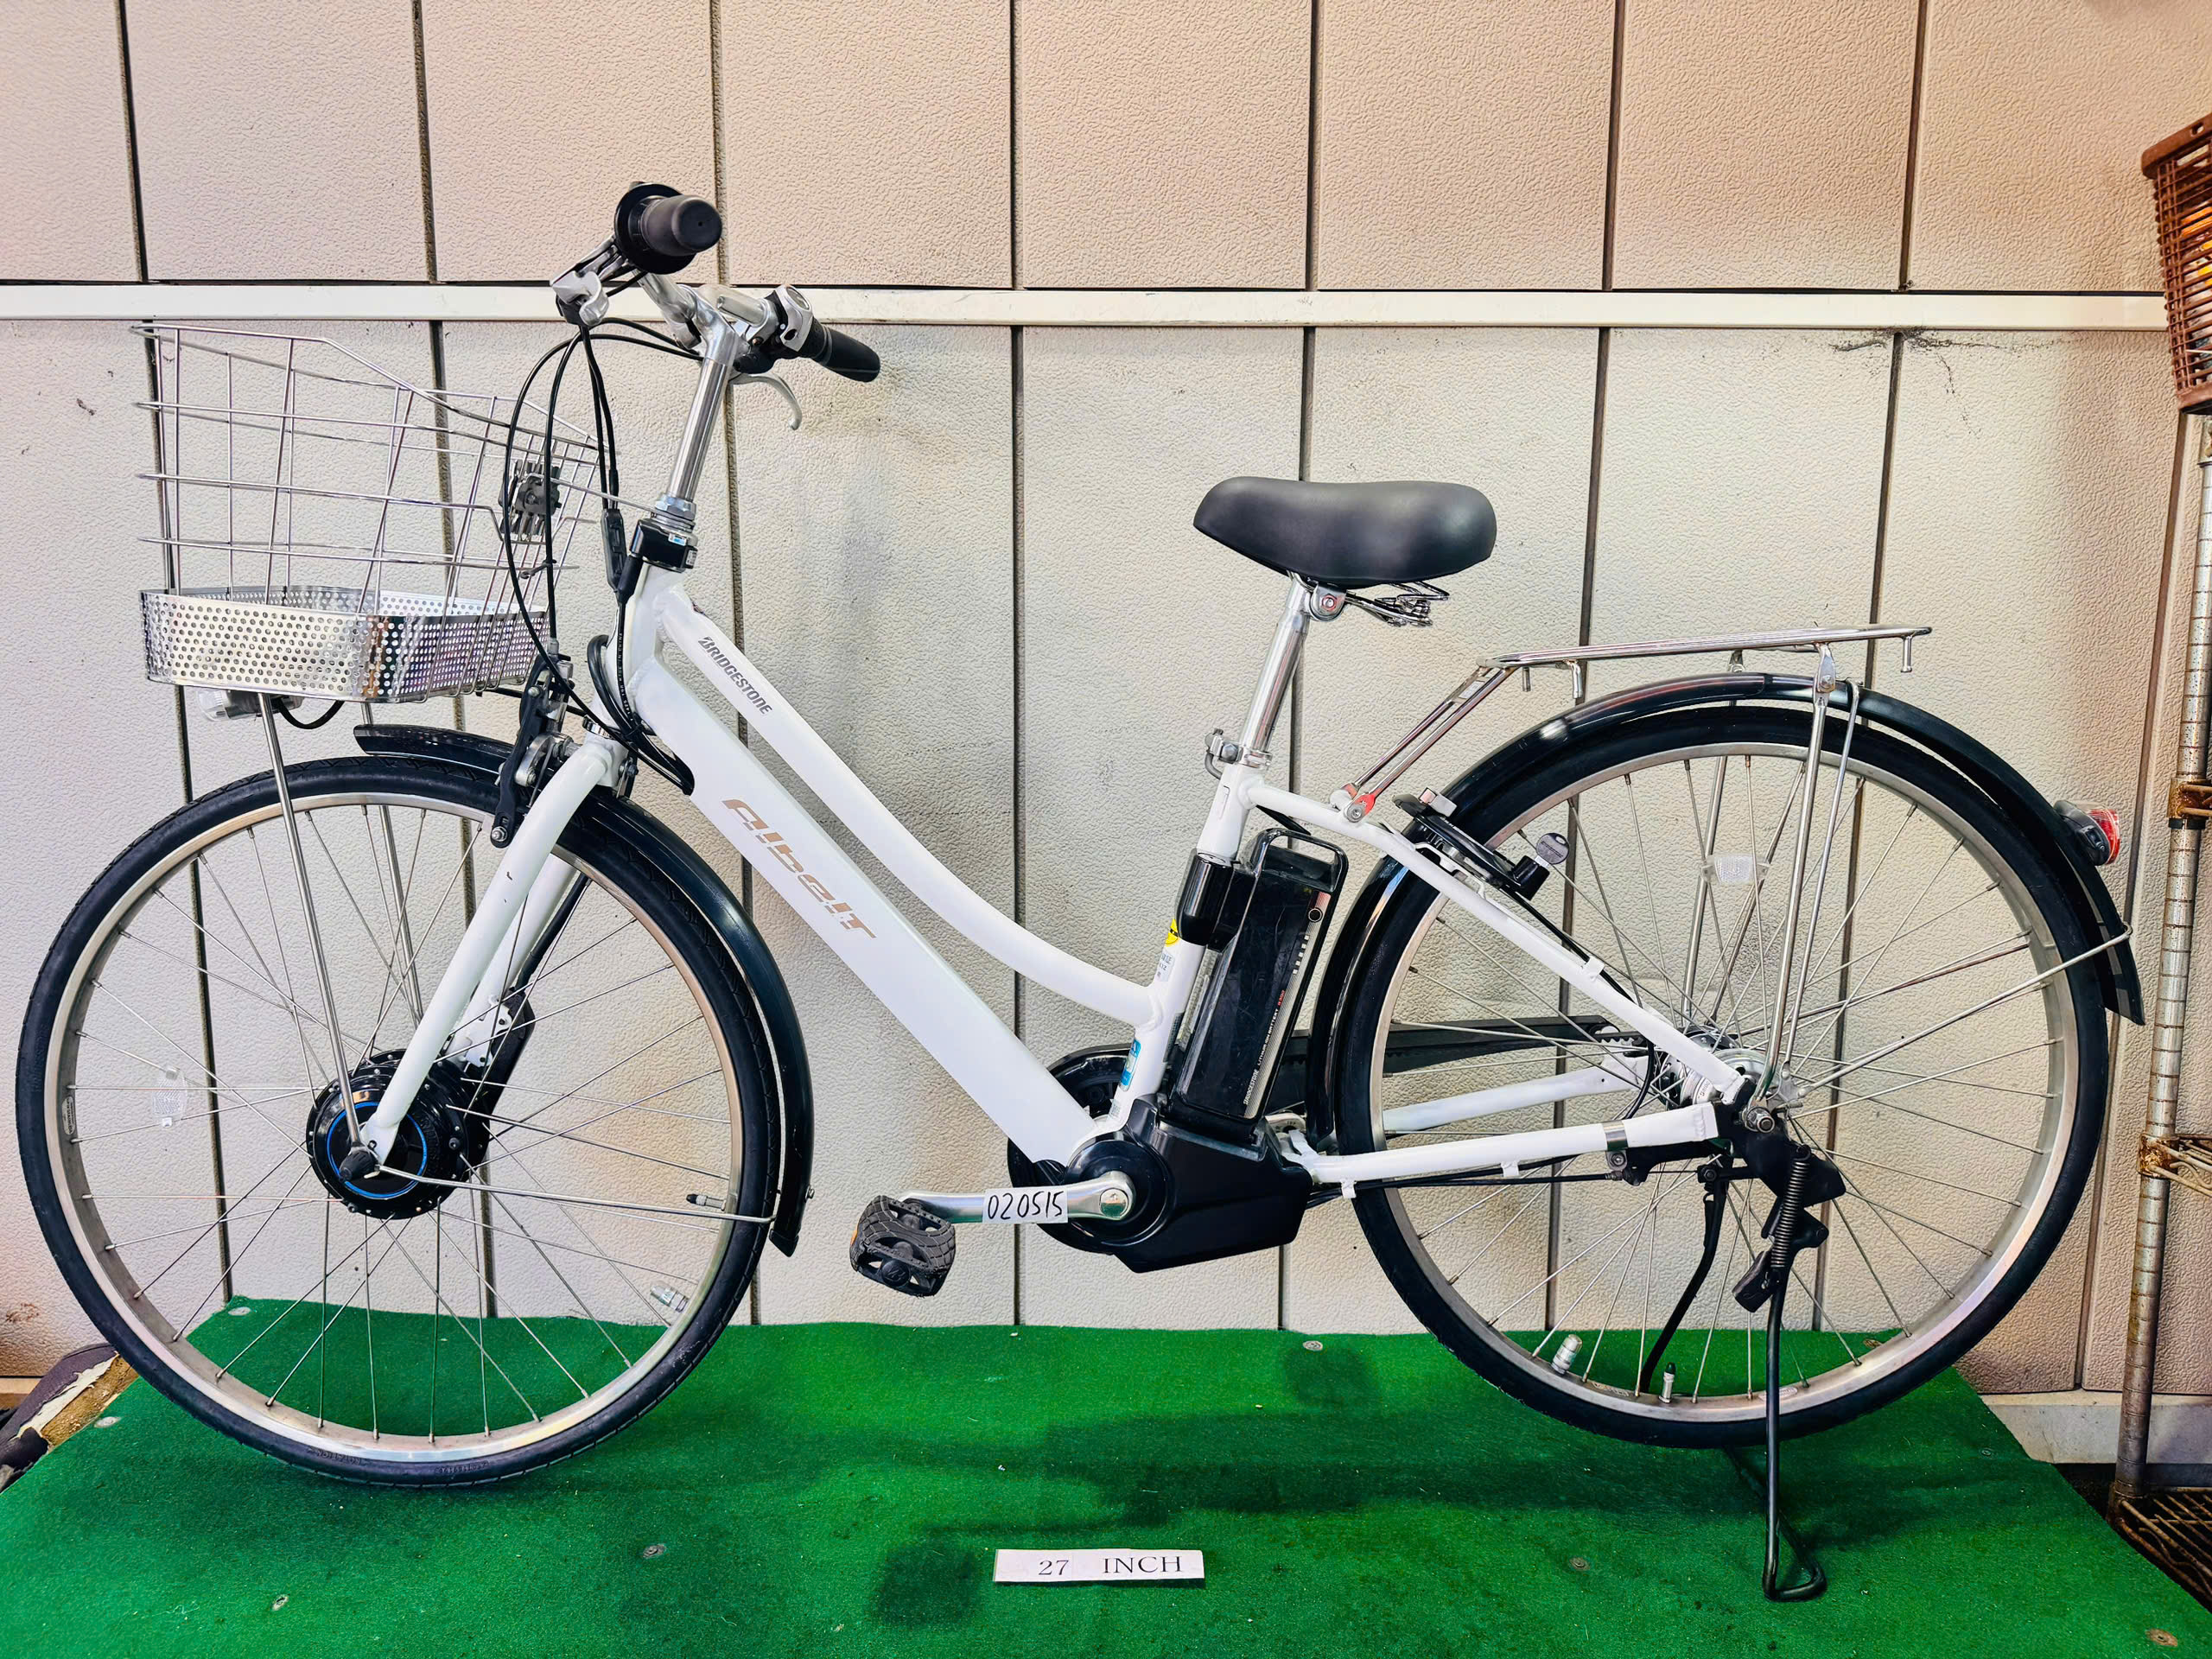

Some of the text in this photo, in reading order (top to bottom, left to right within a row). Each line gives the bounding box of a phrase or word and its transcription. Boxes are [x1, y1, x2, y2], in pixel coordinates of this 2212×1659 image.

[697, 635, 773, 715] BRIDGESTONE
[1243, 1068, 1259, 1106] BRIDGESTONE
[987, 1190, 1065, 1220] 020515
[1038, 1555, 1183, 1576] 27 INCH
